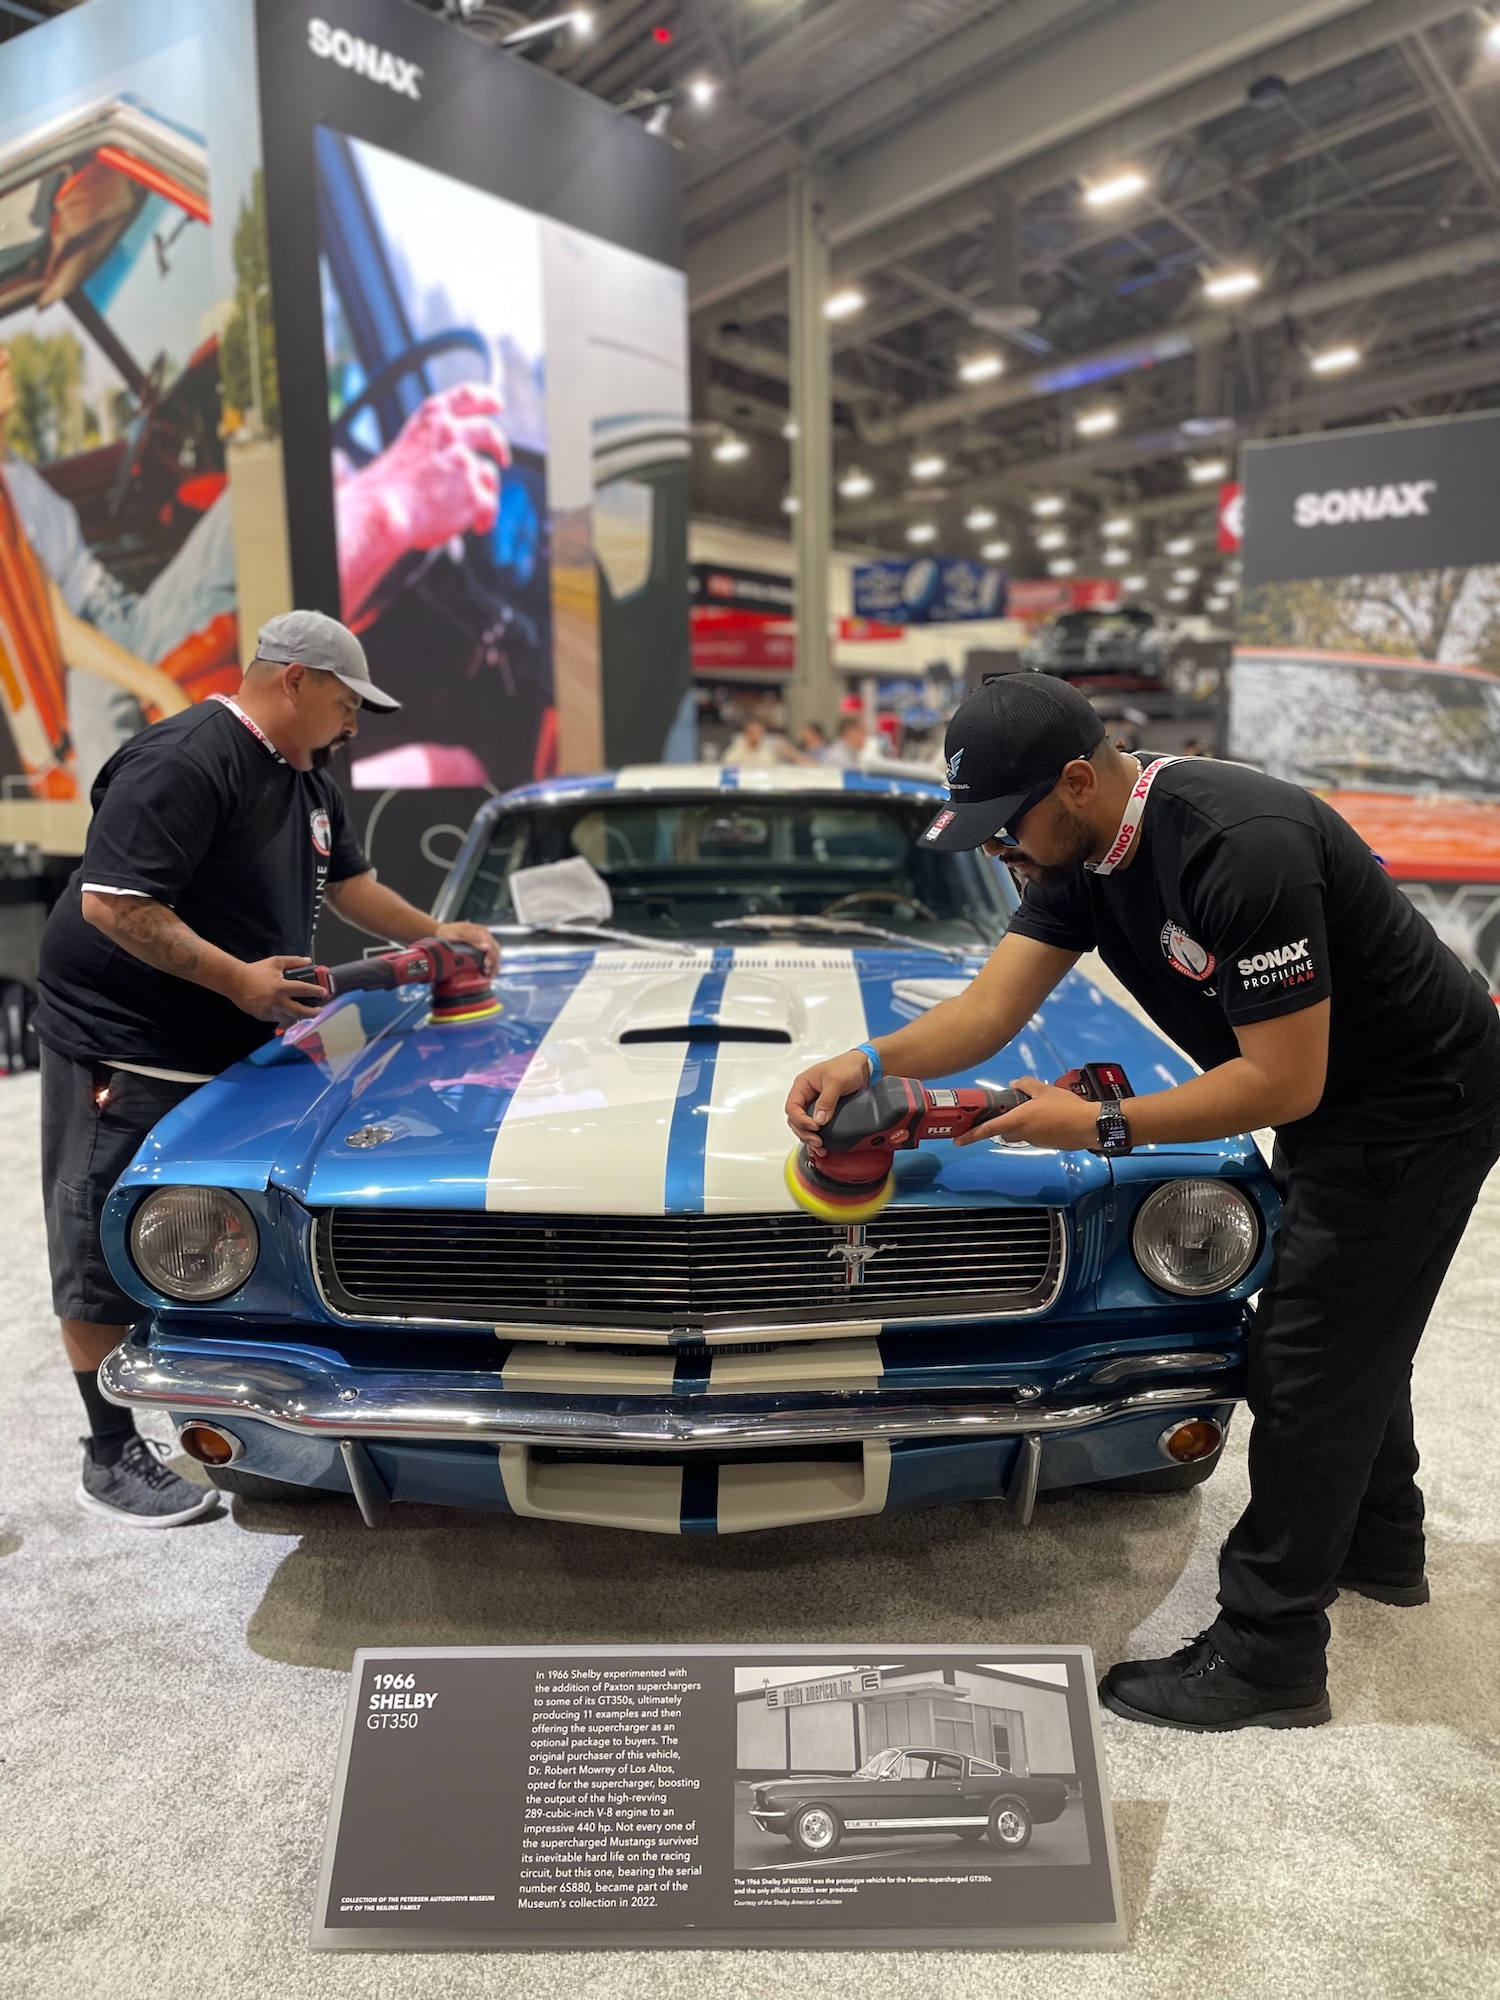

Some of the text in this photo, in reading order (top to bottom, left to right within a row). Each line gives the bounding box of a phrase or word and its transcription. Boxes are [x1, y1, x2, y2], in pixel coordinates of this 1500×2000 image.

[308, 17, 422, 100] SONAX
[1293, 480, 1432, 527] SONAX
[1133, 761, 1165, 799] SONAX
[1105, 824, 1134, 865] SONAX
[1238, 939, 1308, 975] SONAX
[1243, 959, 1314, 990] PROFILINE
[1282, 971, 1315, 988] TEAM
[891, 1129, 905, 1140] FLEX
[928, 1126, 952, 1134] FLEX
[536, 1667, 687, 1680] In 1966 Shelby experimented with
[374, 1674, 416, 1689] 1966
[535, 1680, 701, 1693] the addition of Paxton superchargers
[534, 1693, 682, 1706] to some of its GT350s, ultimately
[783, 1688, 803, 1704] shelby
[806, 1682, 838, 1700] american
[369, 1693, 438, 1710] SHELBY
[366, 1713, 418, 1729] GT350
[533, 1707, 681, 1722] producing 11 examples and then
[532, 1721, 675, 1735] offering the supercharger as an
[531, 1734, 678, 1749] optional package to buyers. The
[530, 1748, 681, 1763] original purchaser of this vehicle,
[529, 1762, 675, 1776] Dr. Robert Mowrey of Los Altos,
[527, 1777, 700, 1792] opted for the supercharger, boosting
[526, 1791, 667, 1805] the output of the high-revving
[525, 1806, 674, 1819] 289-cubic-inch V-8 engine to an
[524, 1820, 696, 1835] impressive 440 hp. Not every one of
[523, 1834, 698, 1850] the supercharged Mustangs survived
[522, 1850, 690, 1863] its inevitable hard life on the racing
[520, 1864, 702, 1879] circuit, but this one, bearing the serial
[519, 1882, 557, 1893] number
[595, 1881, 634, 1892] became
[637, 1882, 657, 1894] part
[660, 1880, 670, 1891] of
[672, 1880, 688, 1891] the
[734, 1878, 745, 1886] The
[747, 1878, 760, 1886] 1966
[762, 1877, 780, 1887] Shelby
[825, 1877, 834, 1885] the
[836, 1877, 864, 1886] prototype
[866, 1876, 886, 1884] vehicle
[887, 1876, 895, 1884] for
[897, 1876, 906, 1884] the
[907, 1875, 968, 1885] Paxton-supercharged
[969, 1875, 991, 1883] GT350s
[734, 1887, 745, 1895] and
[746, 1887, 755, 1895] the
[757, 1886, 769, 1896] only
[771, 1886, 790, 1894] official
[829, 1885, 858, 1895] produced.
[341, 1896, 377, 1904] COLLECTION
[400, 1895, 429, 1903] PETERSEN
[430, 1895, 468, 1903] AUTOMOTIVE
[469, 1894, 495, 1902] MUSEUM
[569, 1896, 616, 1908] collection
[620, 1897, 628, 1906] in
[631, 1895, 658, 1907] 2022.
[734, 1899, 756, 1908] Courtesy
[773, 1898, 790, 1907] Shelby
[816, 1898, 842, 1906] Collection
[340, 1904, 353, 1912] GIFT
[354, 1904, 363, 1912] OF
[364, 1904, 375, 1912] THE
